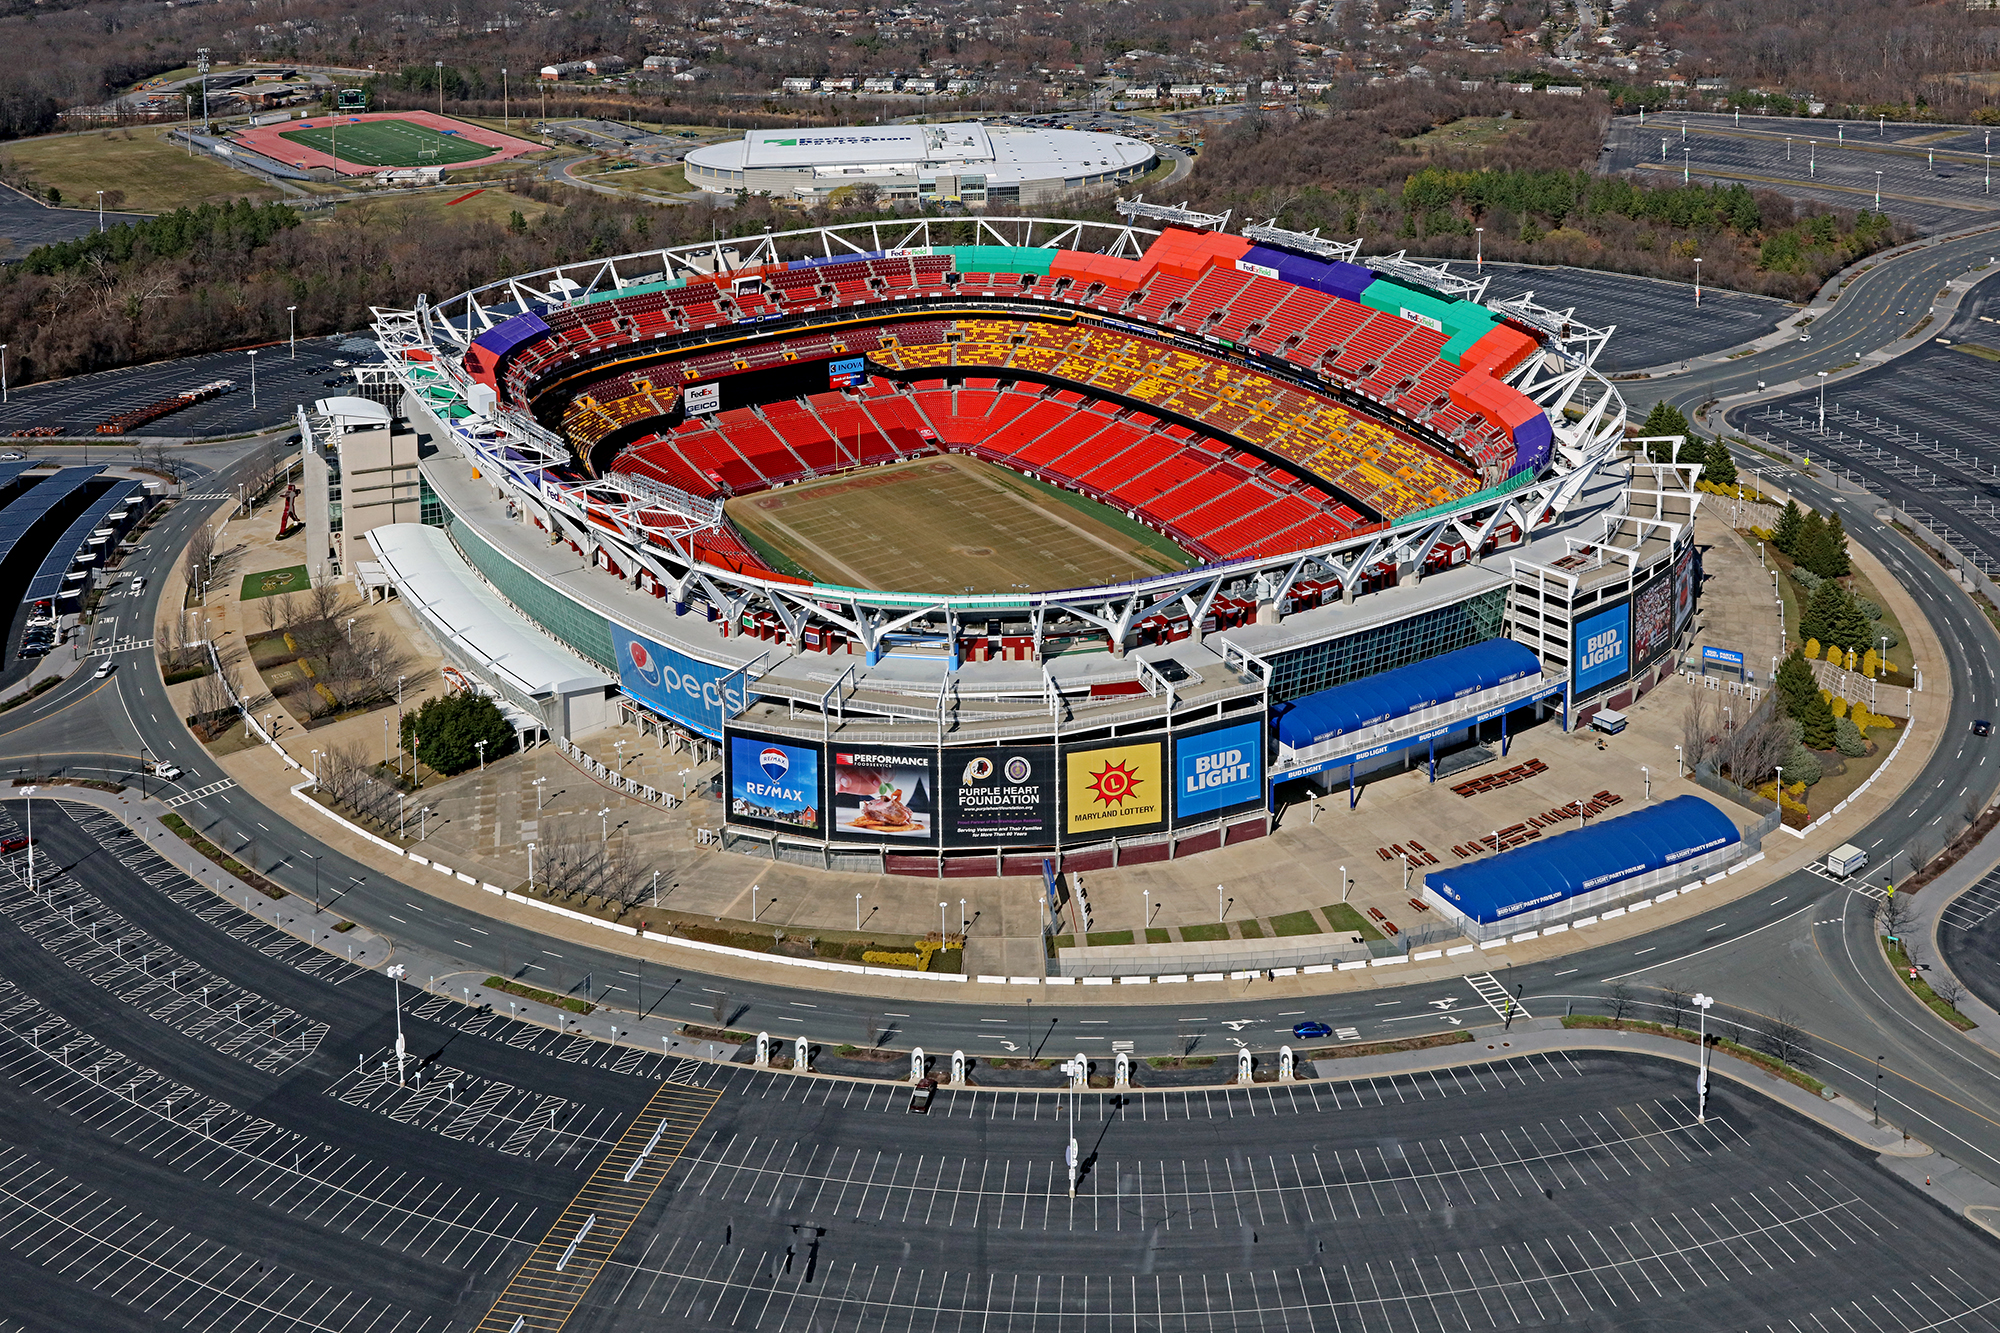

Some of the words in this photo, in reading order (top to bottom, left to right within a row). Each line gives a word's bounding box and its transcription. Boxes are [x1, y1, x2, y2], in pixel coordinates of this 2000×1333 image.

[890, 249, 928, 257] FedExField
[1243, 263, 1272, 276] FedExField
[552, 297, 585, 311] FedExField
[1407, 312, 1435, 328] FedExField
[838, 362, 862, 370] INOVA
[690, 388, 712, 398] FedEx
[686, 400, 718, 412] GEICO
[1588, 628, 1617, 654] BUD
[1582, 640, 1622, 671] LIGHT
[1542, 686, 1558, 698] LIGHT
[1490, 707, 1506, 717] LIGHT
[1432, 727, 1448, 737] LIGHT
[1356, 752, 1369, 760] BUD
[1370, 746, 1388, 756] LIGHT
[764, 756, 786, 765] RE/MAX
[854, 754, 928, 766] PERFORMANCE
[1196, 750, 1241, 774] BUD
[1187, 762, 1250, 792] LIGHT
[1288, 770, 1302, 778] BUD
[1303, 764, 1322, 774] LIGHT
[1110, 778, 1120, 790] L
[746, 782, 802, 802] RE/MAX
[959, 787, 1000, 796] PURPLE
[1003, 786, 1039, 795] HEART
[959, 795, 1040, 806] FOUNDATION
[1075, 810, 1117, 822] MARYLAND
[1120, 806, 1154, 816] LOTTERY
[1677, 850, 1690, 858] LIGHT
[1690, 844, 1705, 853] PARTY
[1706, 837, 1726, 848] PAVILION
[1594, 876, 1608, 884] LIGHT
[1609, 870, 1625, 879] PARTY
[1625, 864, 1646, 874] PAVILION
[1524, 898, 1540, 907] PARTY
[1540, 891, 1562, 902] PAVILION
